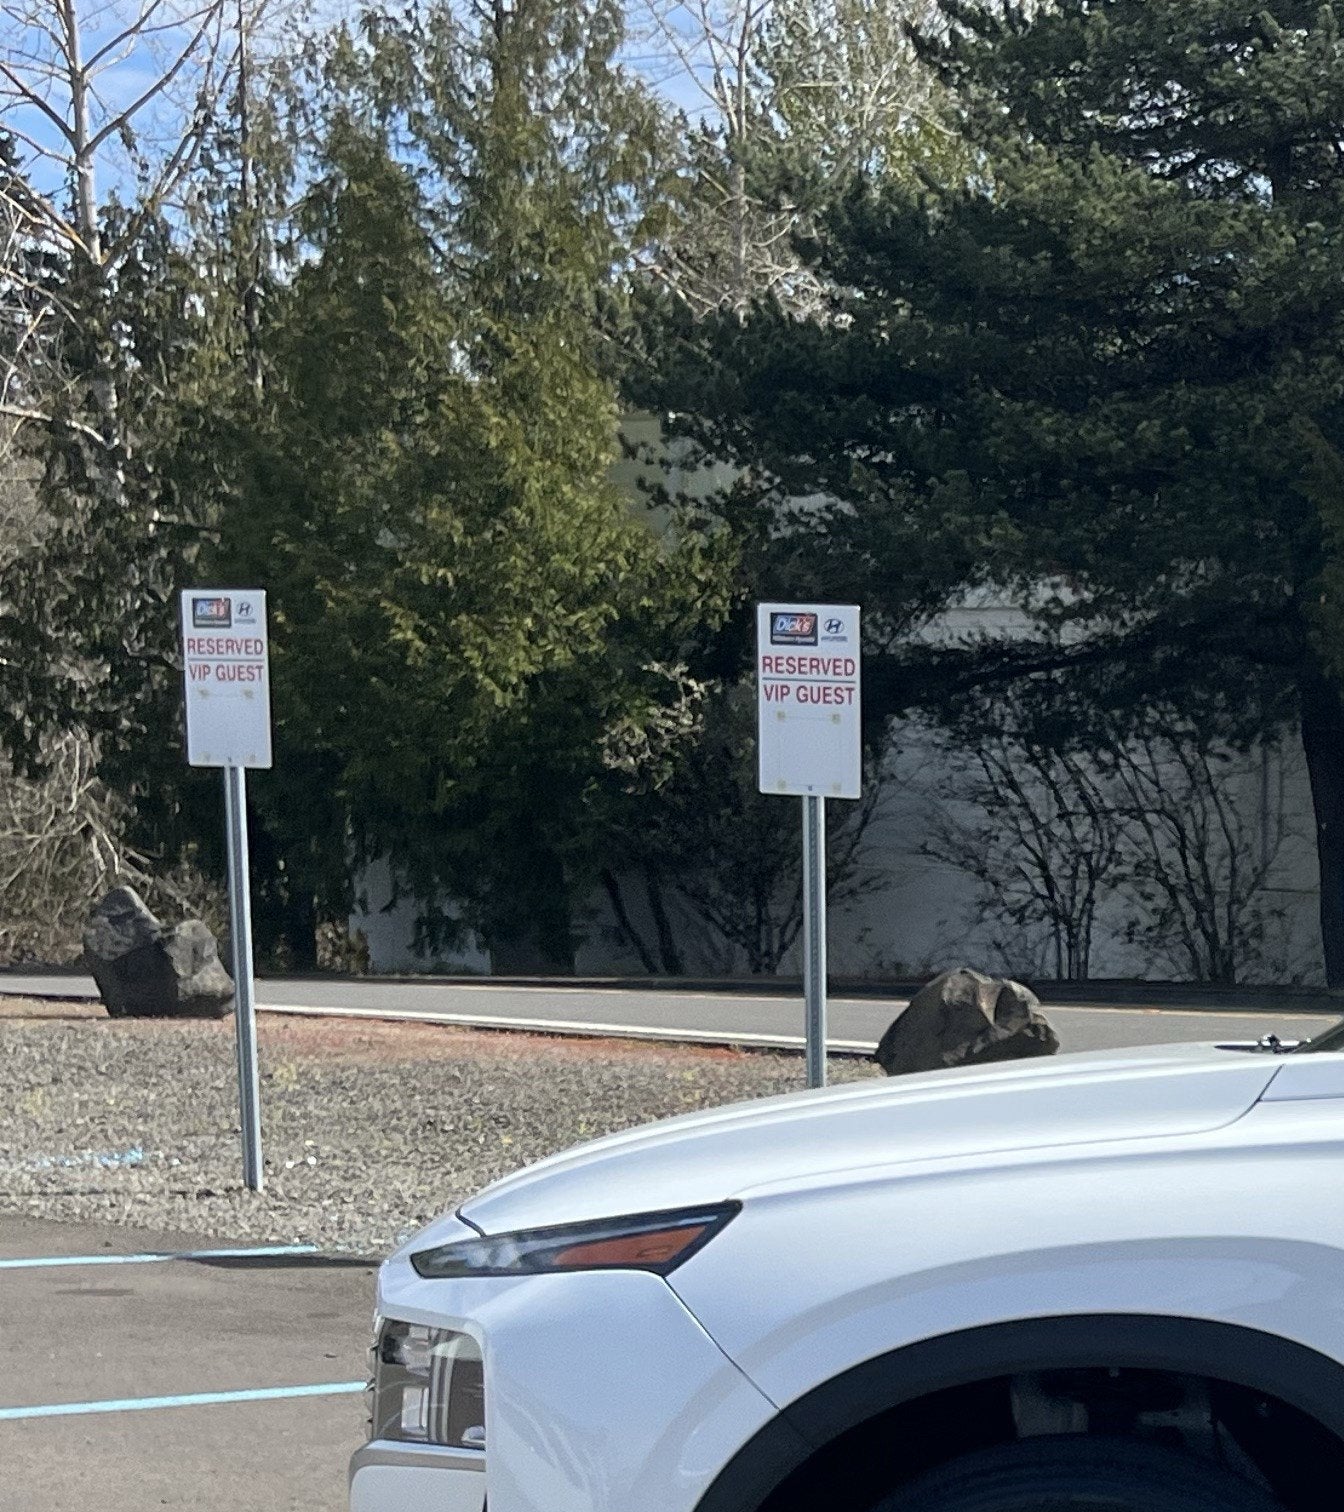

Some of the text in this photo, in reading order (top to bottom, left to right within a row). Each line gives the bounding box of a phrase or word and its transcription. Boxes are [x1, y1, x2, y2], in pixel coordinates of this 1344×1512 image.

[187, 638, 264, 656] RESERVED
[189, 664, 264, 682] VIP GUEST
[762, 655, 856, 677] RESERVED
[763, 683, 856, 706] VIP GUEST
